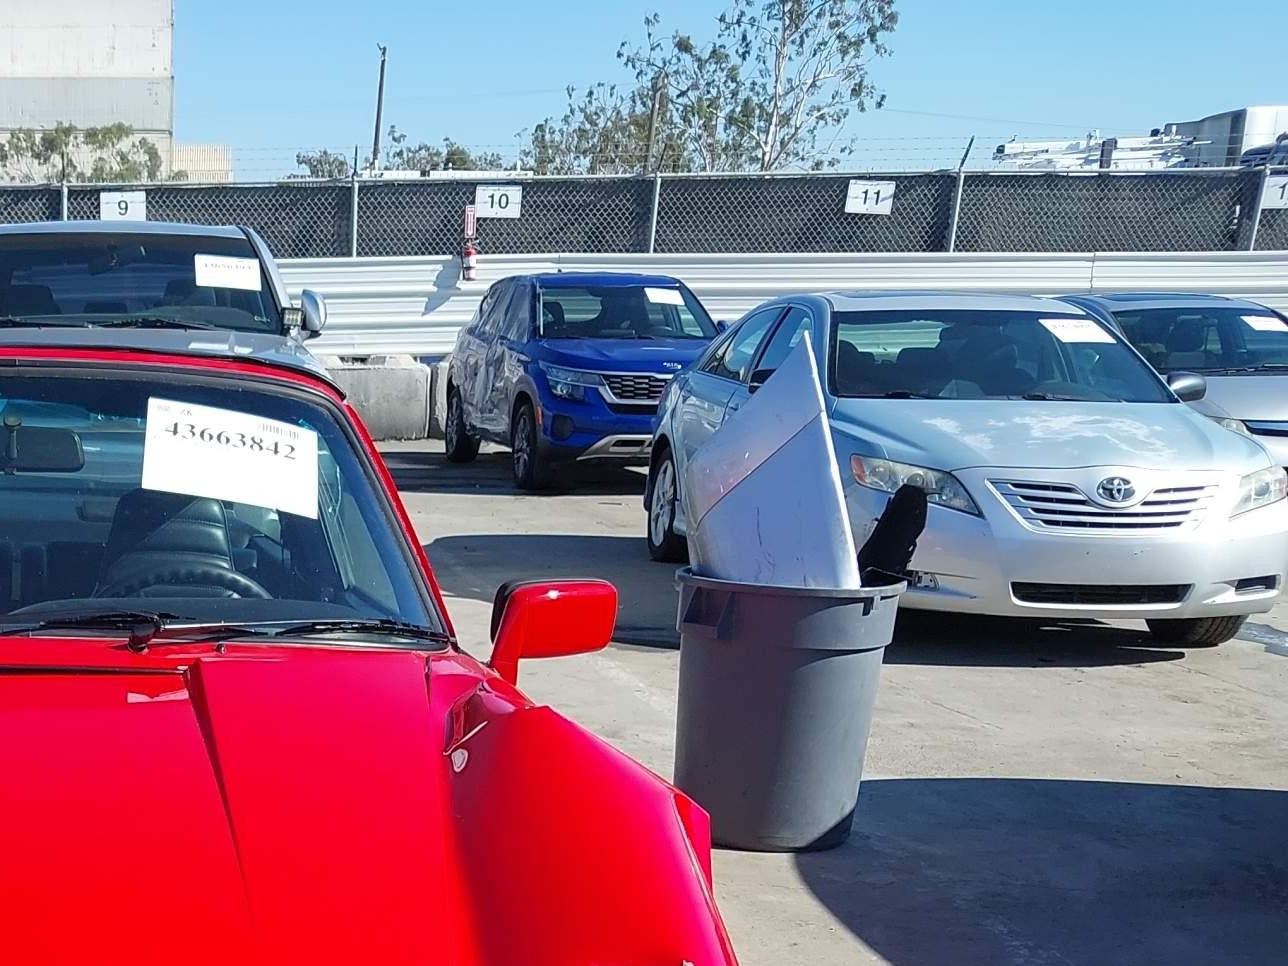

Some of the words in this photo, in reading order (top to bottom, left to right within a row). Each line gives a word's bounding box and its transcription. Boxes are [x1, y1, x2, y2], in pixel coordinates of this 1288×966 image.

[487, 193, 510, 209] 10
[861, 188, 881, 206] 11
[117, 199, 129, 216] 9
[164, 421, 296, 460] 43663842
